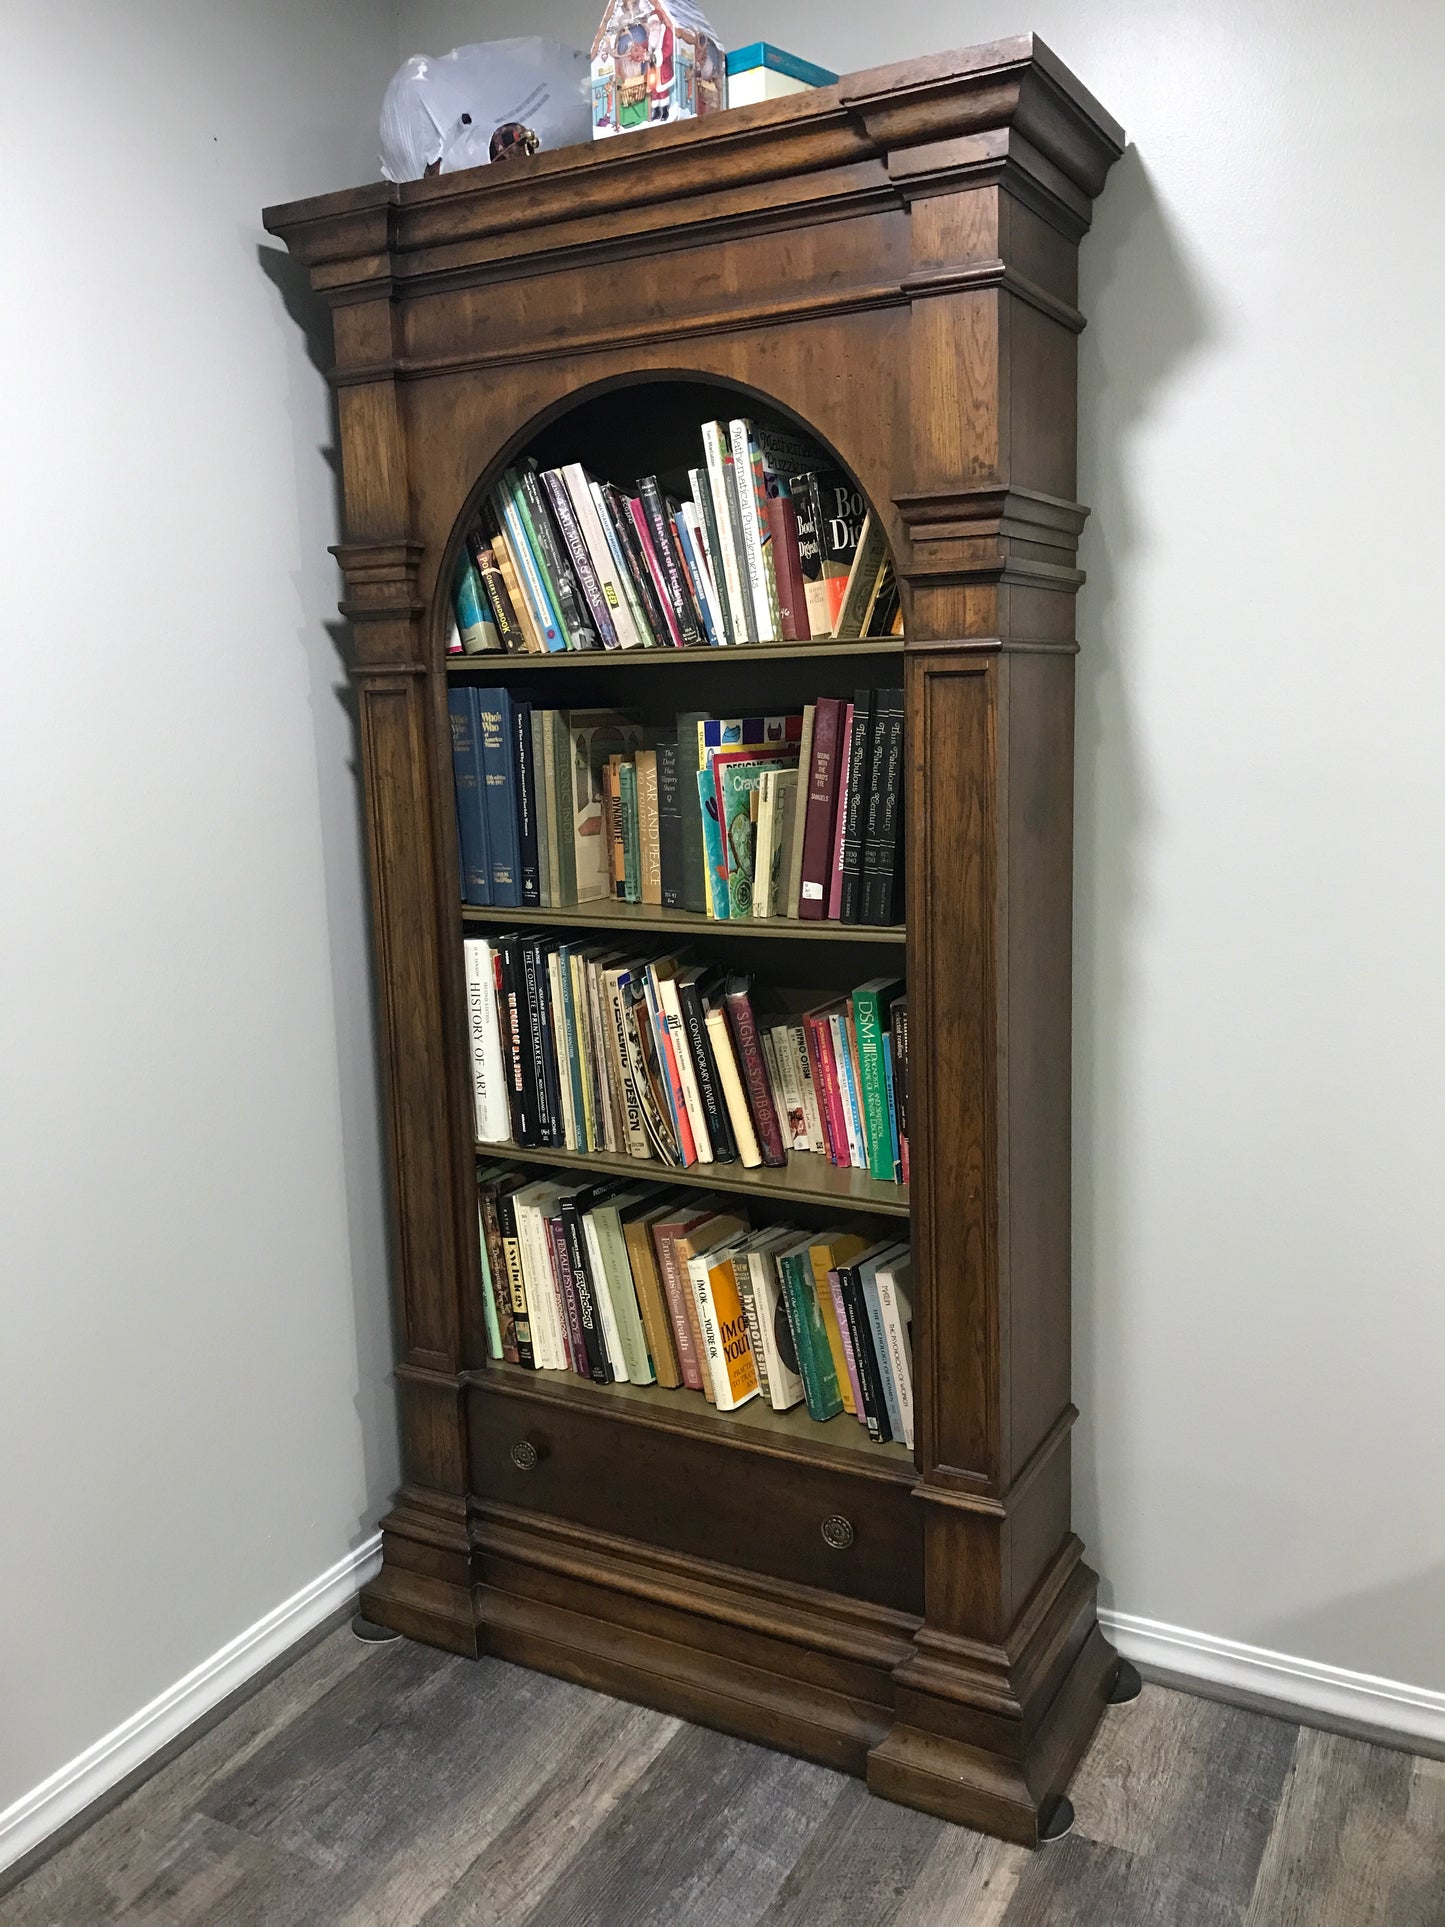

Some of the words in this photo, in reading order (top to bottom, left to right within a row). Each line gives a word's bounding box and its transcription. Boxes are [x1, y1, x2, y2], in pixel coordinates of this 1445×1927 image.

[731, 426, 752, 509] Mathematical
[742, 512, 761, 589] Puzzlements
[833, 487, 864, 518] Bo
[653, 513, 666, 536] The
[659, 537, 671, 555] Art
[664, 555, 675, 567] of
[568, 530, 587, 567] MUSIC
[584, 574, 602, 608] IDEAS
[492, 594, 511, 634] HANDBOOK
[605, 585, 618, 605] USED
[482, 722, 499, 732] Who
[854, 723, 865, 745] This
[873, 722, 885, 744] This
[890, 721, 902, 744] This
[645, 767, 656, 801] WAR
[734, 776, 760, 791] Crayo
[851, 747, 864, 792] Fabulous
[870, 745, 883, 791] Fabulous
[886, 745, 900, 791] Fabulous
[612, 796, 624, 845] DYNAMITE!
[647, 806, 658, 838] AND
[847, 793, 860, 835] Century
[867, 792, 880, 835] Century
[882, 792, 896, 835] Century
[651, 844, 661, 886] PEACE
[526, 967, 537, 1008] COMPLETE
[470, 982, 483, 1042] HISTORY
[666, 1013, 681, 1032] art
[474, 1047, 484, 1066] OF
[531, 1013, 542, 1065] PRINTMAKER
[794, 1027, 806, 1053] HYPNO
[800, 1054, 811, 1079] OTISM
[475, 1070, 486, 1098] ART
[689, 1016, 711, 1084] CONTEMPORARY
[703, 1083, 717, 1116] JEWELRY
[736, 1011, 756, 1056] SIGNS
[748, 1066, 774, 1137] SYMBOLS
[863, 1053, 872, 1080] MANUAL
[623, 1077, 641, 1131] DESIGN
[557, 1238, 568, 1273] FEMALE
[563, 1273, 578, 1332] PSYCHOLOGY
[574, 1270, 593, 1329] psychology
[661, 1237, 674, 1289] Emotions
[676, 1314, 689, 1351] Health
[698, 1292, 707, 1304] OK
[703, 1318, 715, 1345] YOU'RE
[747, 1293, 767, 1375] hypnotism
[708, 1346, 718, 1359] OK
[874, 1322, 888, 1364] PSYCHOLOGY
[885, 1376, 895, 1401] WOMEN
[890, 1334, 903, 1375] PSYCHOLOGY
